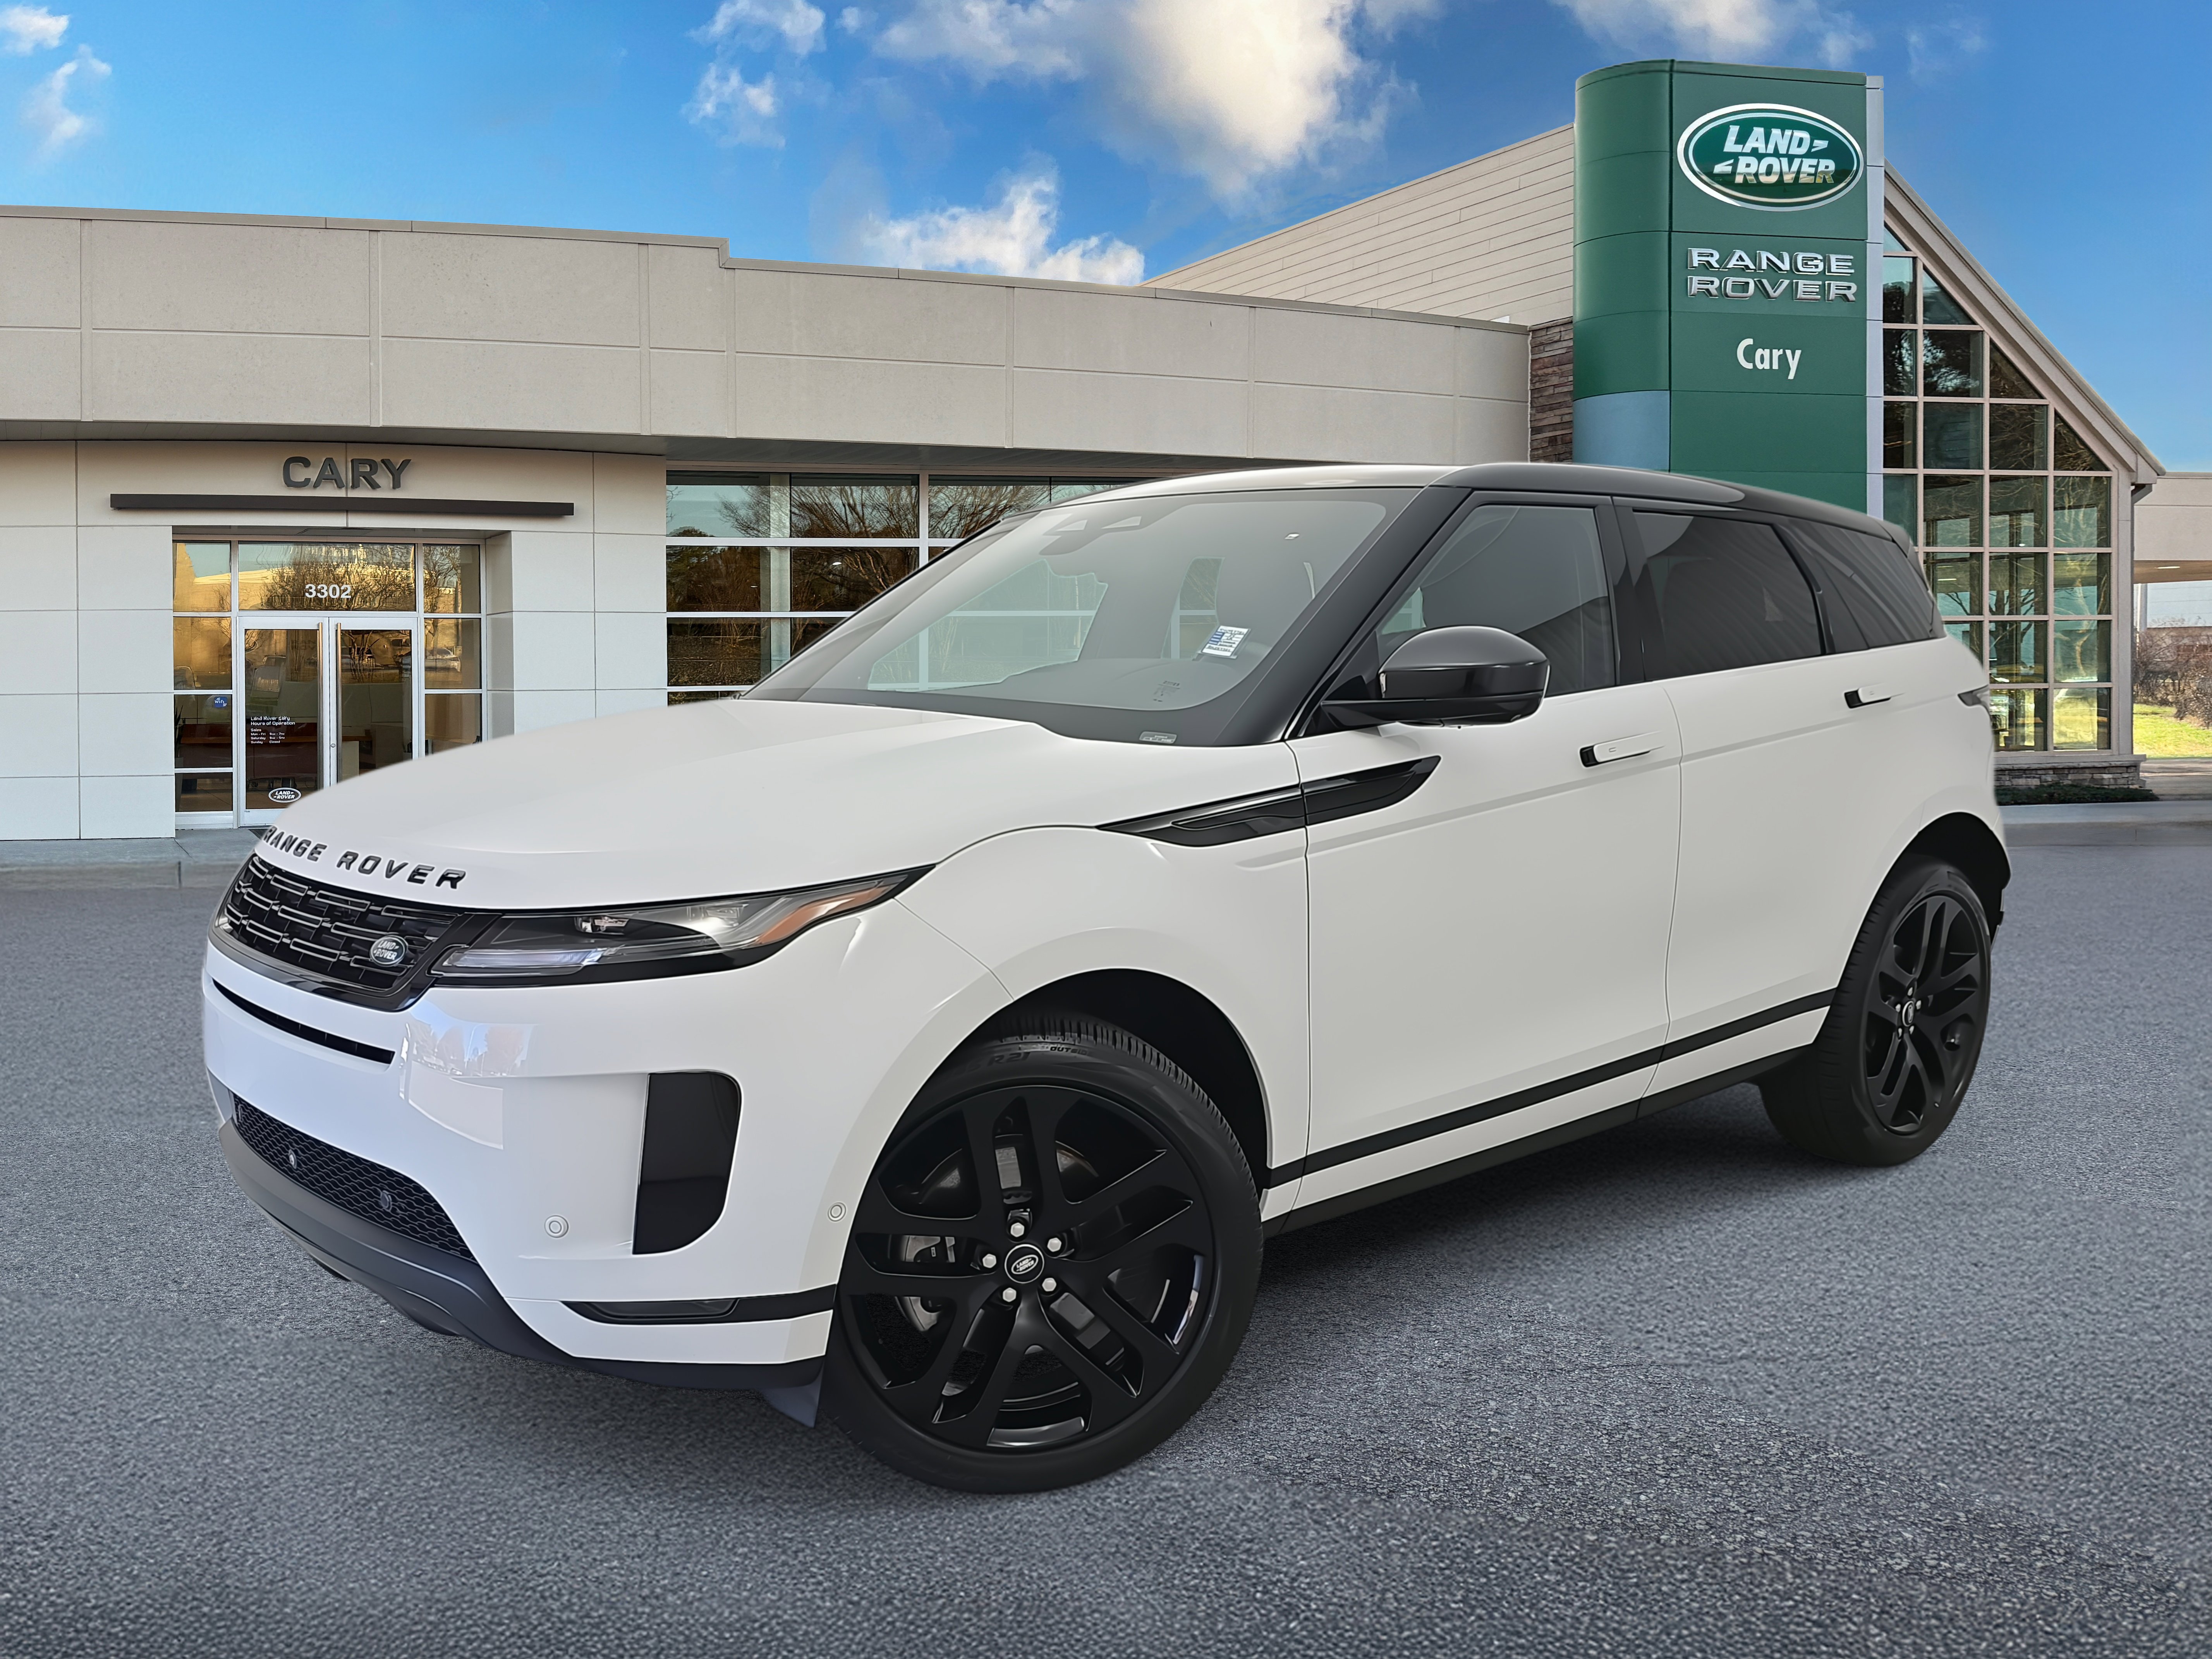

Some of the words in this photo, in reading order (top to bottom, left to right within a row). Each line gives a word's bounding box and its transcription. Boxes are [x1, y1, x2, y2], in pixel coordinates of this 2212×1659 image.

[1723, 125, 1811, 155] LAND
[1735, 156, 1836, 184] ROVER
[1687, 247, 1855, 276] RANGE
[1687, 276, 1858, 302] ROVER
[1736, 338, 1802, 380] Cary
[282, 456, 412, 490] CARY
[305, 584, 352, 599] 3302
[263, 825, 328, 862] RANGE
[336, 850, 466, 890] ROVER
[374, 948, 397, 960] ROVER
[378, 940, 396, 950] LAND
